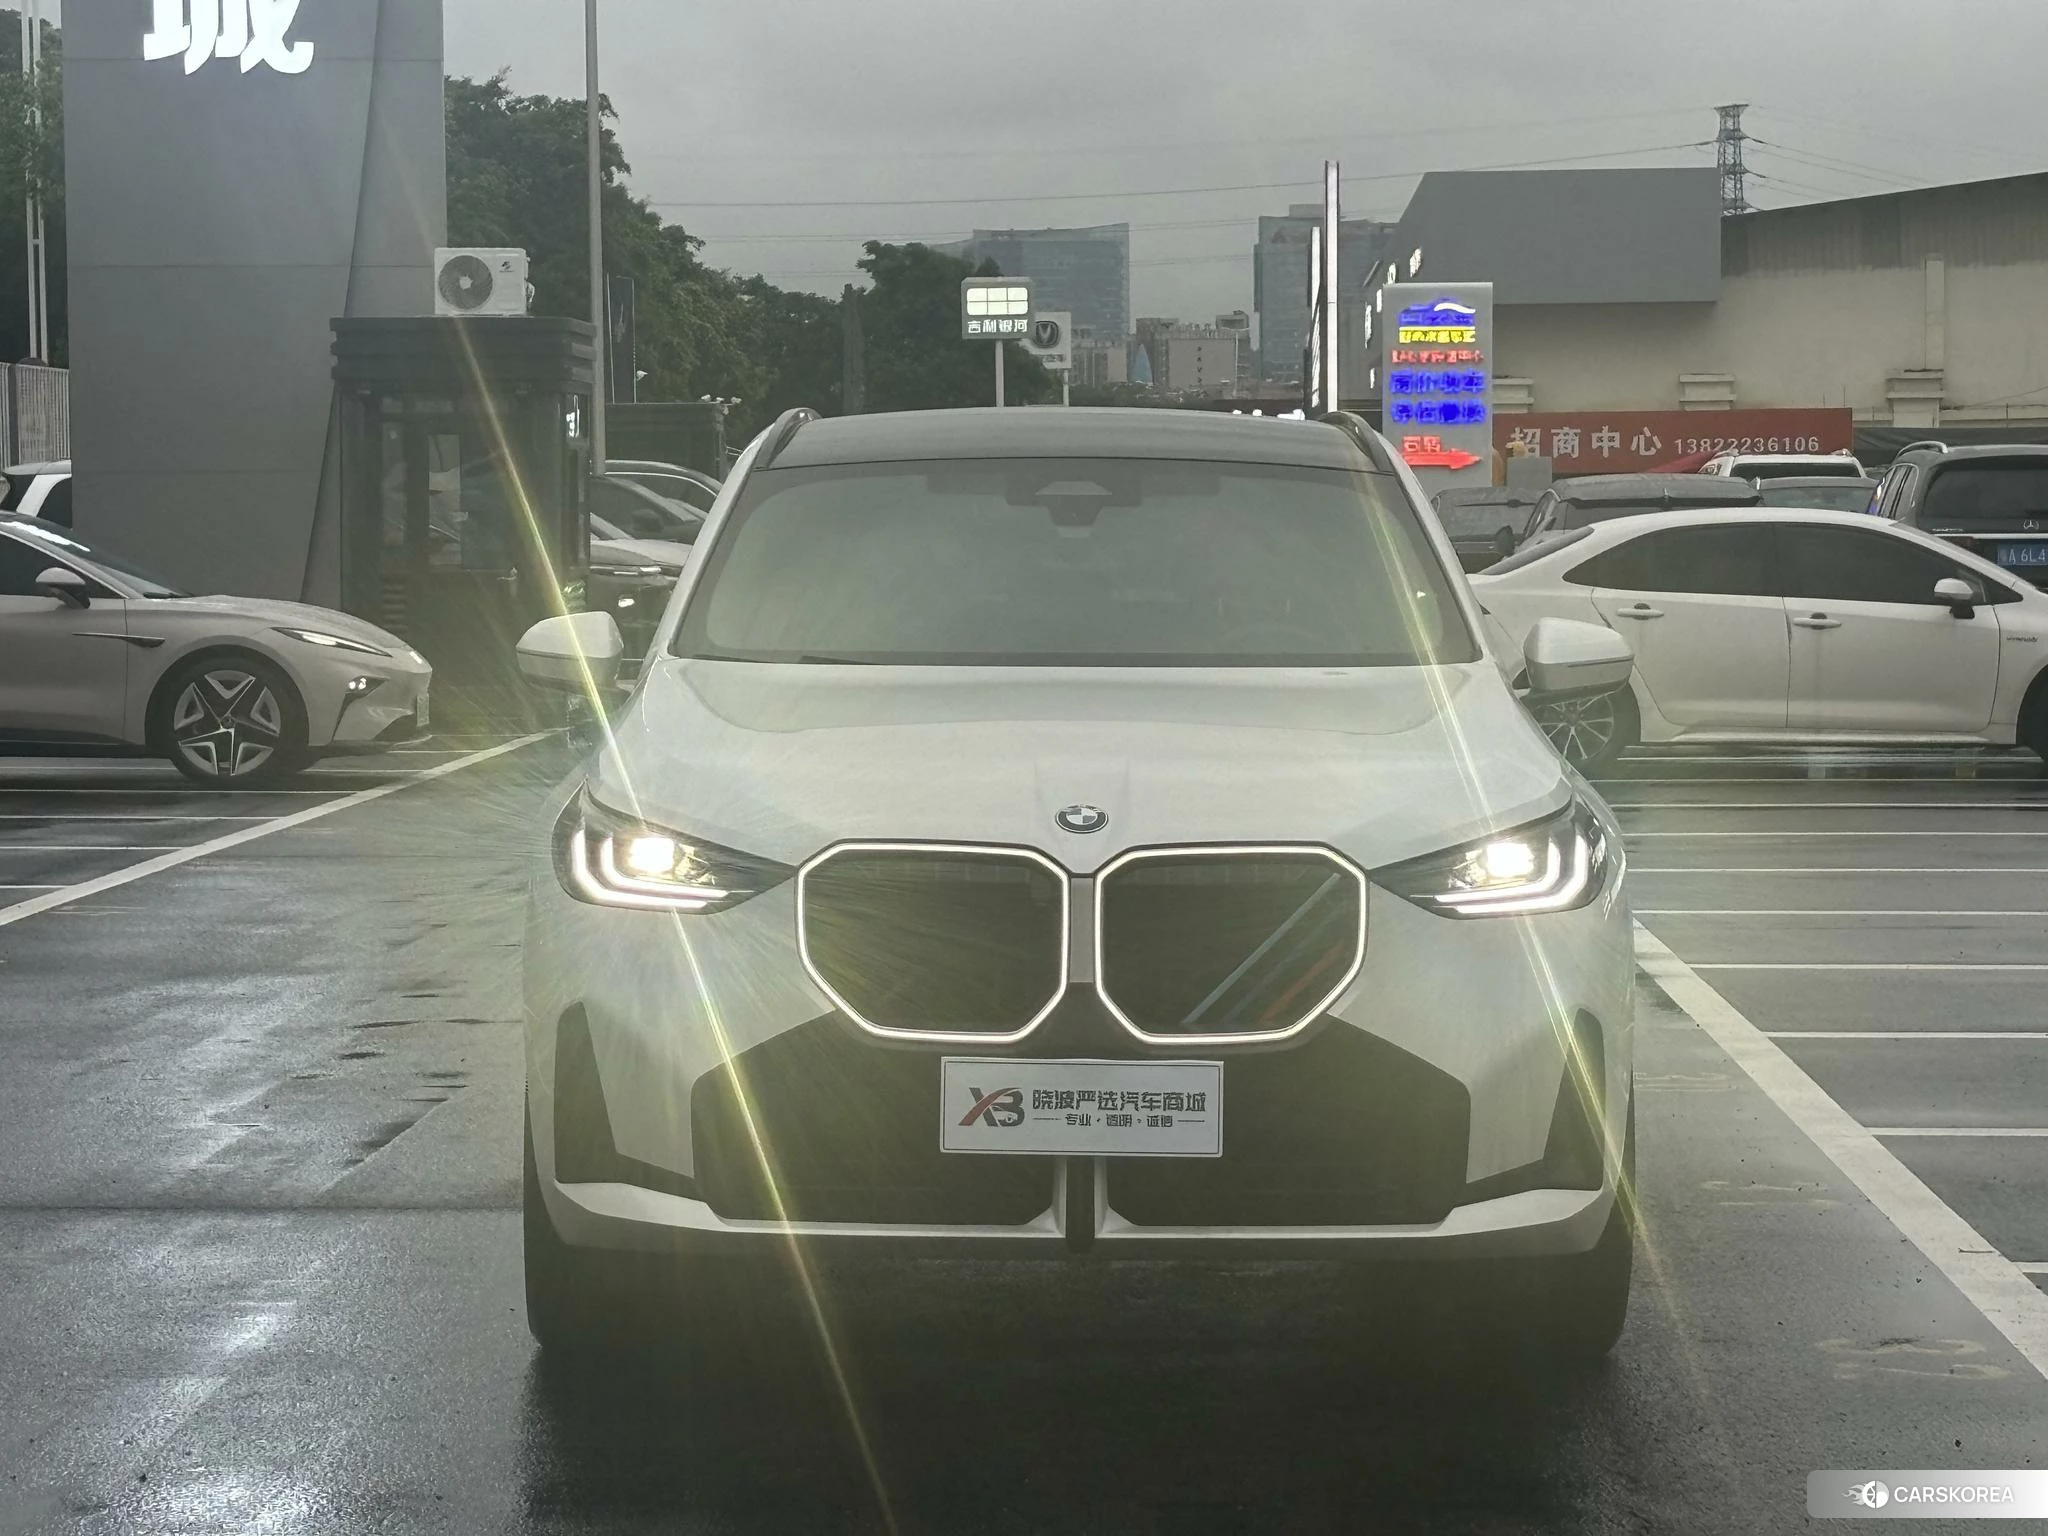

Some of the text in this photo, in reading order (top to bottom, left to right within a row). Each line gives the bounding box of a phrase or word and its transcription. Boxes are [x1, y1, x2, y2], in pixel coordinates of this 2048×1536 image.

[967, 319, 1028, 334] 吉利银河
[1505, 425, 1820, 459] 招商中心 13822236106
